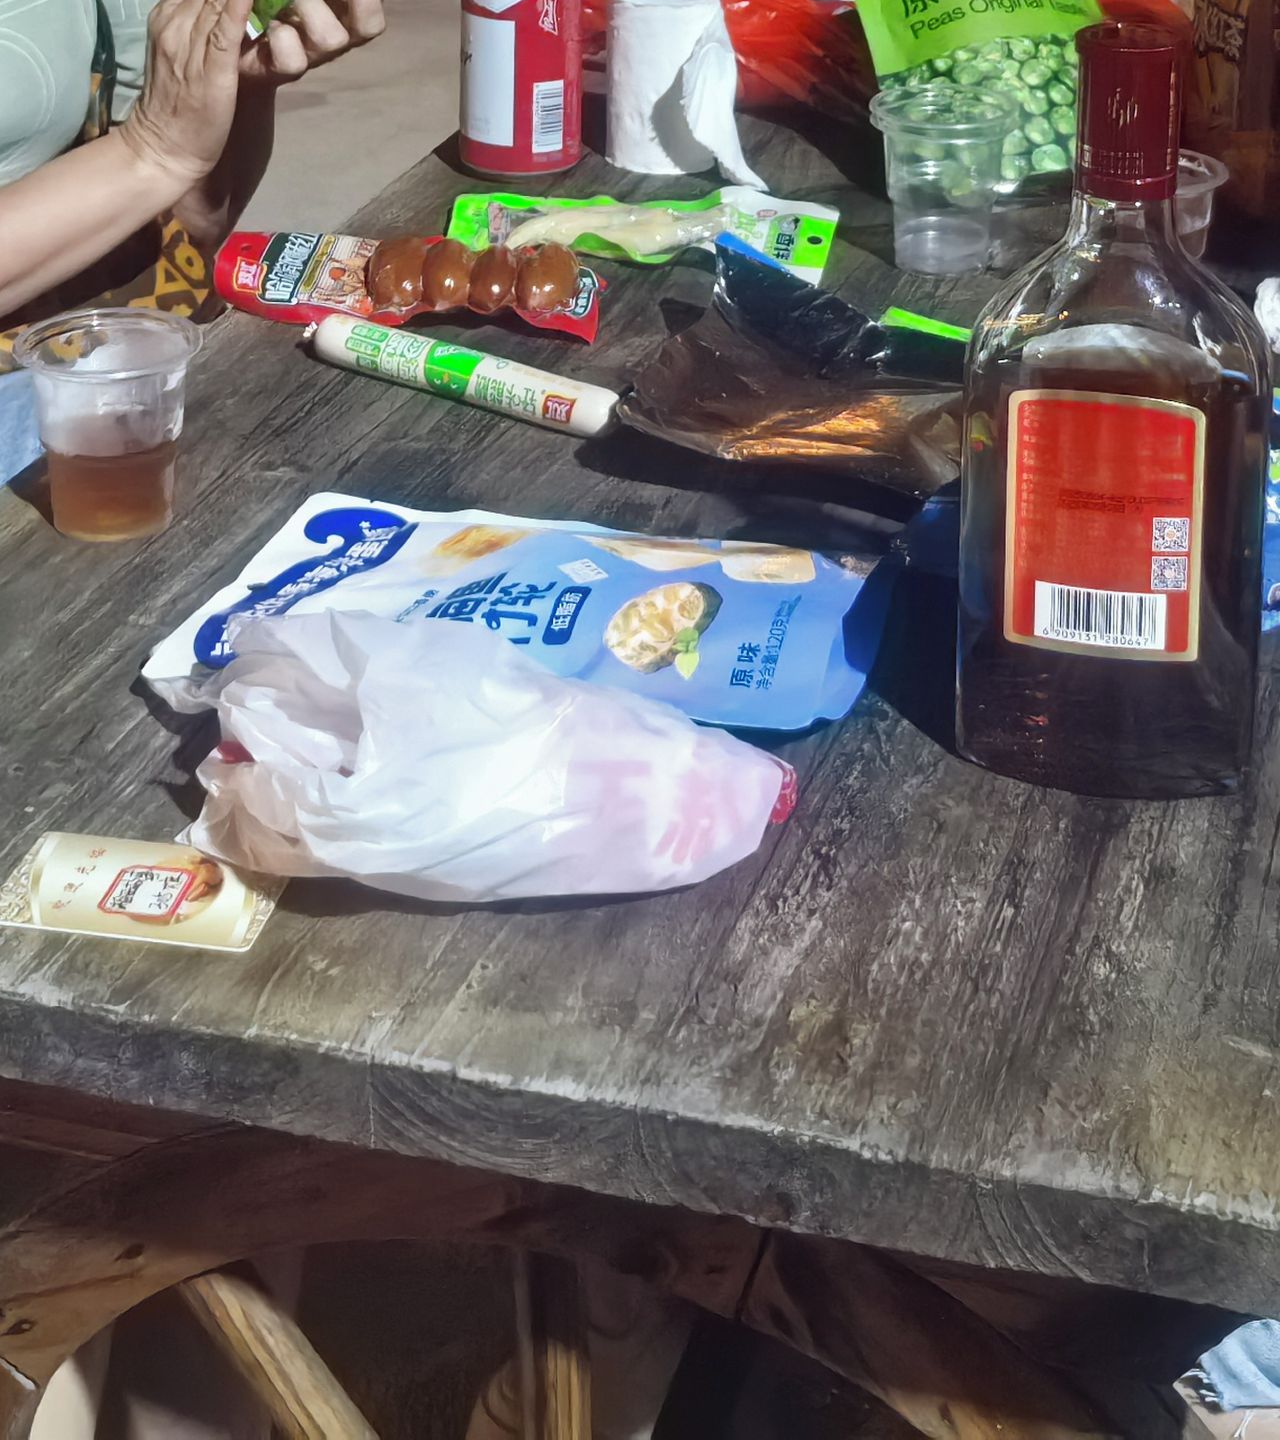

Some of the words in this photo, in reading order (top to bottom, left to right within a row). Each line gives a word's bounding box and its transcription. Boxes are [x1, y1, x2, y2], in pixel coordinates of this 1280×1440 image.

[910, 7, 965, 40] Peas
[1042, 626, 1049, 637] 6
[1055, 627, 1098, 642] 909131
[1105, 634, 1149, 647] 280647
[729, 642, 761, 688] 原味
